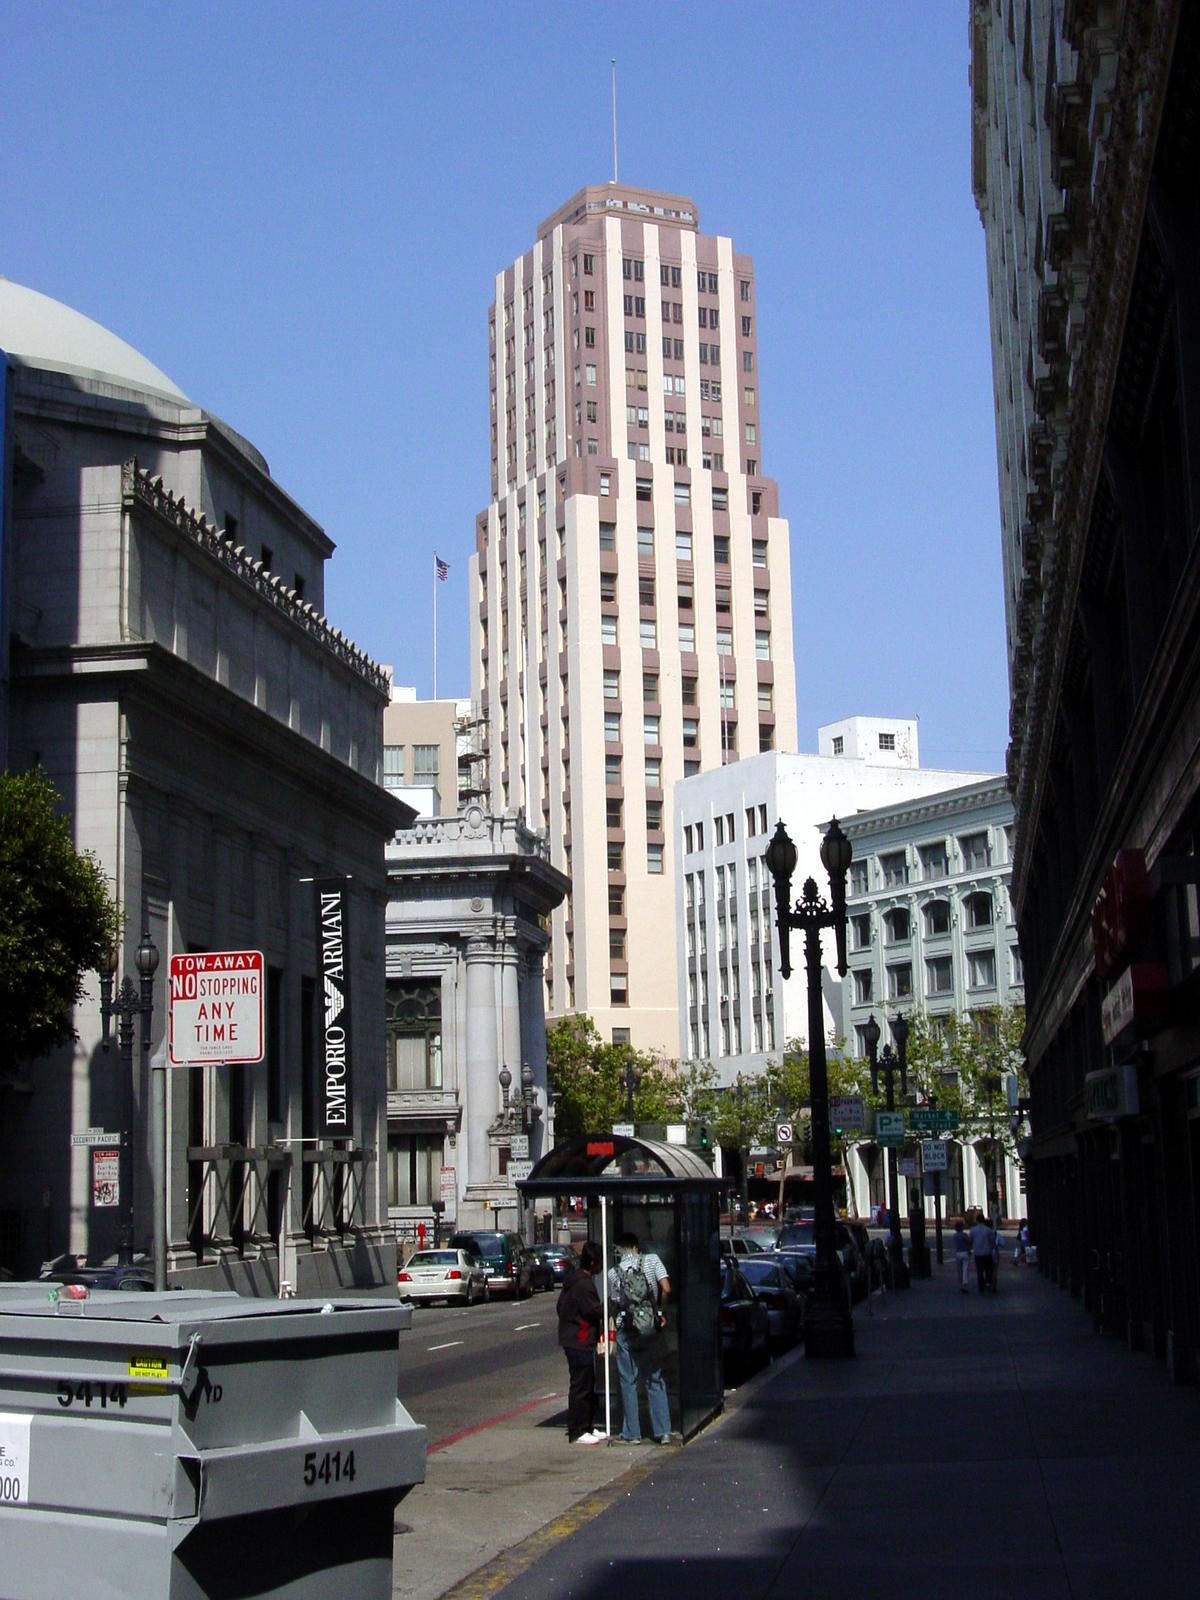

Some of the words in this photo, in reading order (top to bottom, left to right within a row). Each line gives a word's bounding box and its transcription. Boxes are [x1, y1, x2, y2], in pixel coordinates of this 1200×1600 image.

[320, 891, 344, 981] ARMANI
[177, 955, 256, 971] TOW-AWAY
[173, 973, 196, 998] NO
[200, 977, 257, 997] STOPPING
[198, 1001, 235, 1021] ANY
[194, 1023, 238, 1043] TIME
[325, 1026, 347, 1126] EMPORIO
[880, 1116, 892, 1132] P
[931, 1121, 952, 1129] Grant
[73, 1136, 96, 1144] SECURITY
[97, 1135, 118, 1143] PACIFIC
[925, 1152, 945, 1160] BLOCK
[135, 1357, 163, 1369] CAUTION
[56, 1380, 128, 1409] 5414
[204, 1384, 224, 1404] YD
[302, 1450, 357, 1487] 5414
